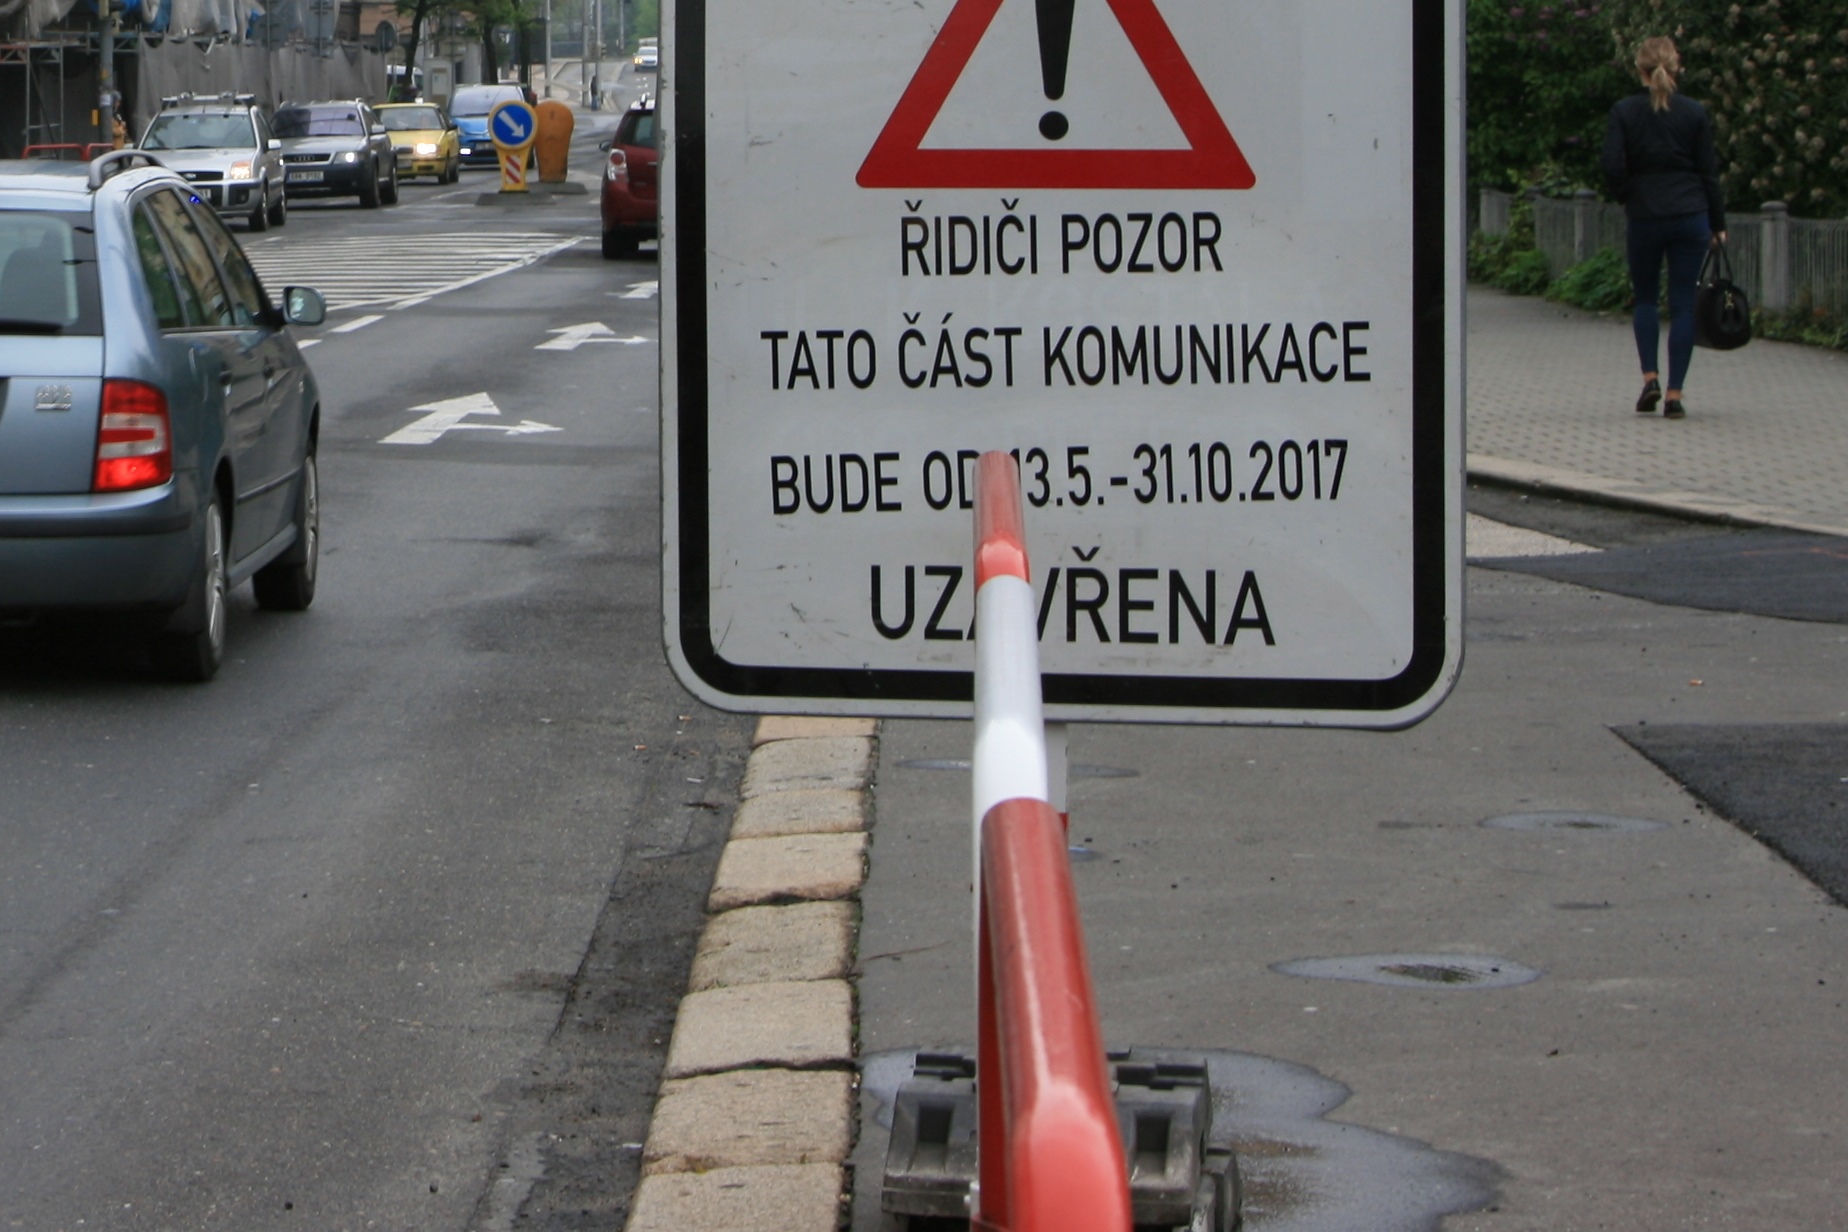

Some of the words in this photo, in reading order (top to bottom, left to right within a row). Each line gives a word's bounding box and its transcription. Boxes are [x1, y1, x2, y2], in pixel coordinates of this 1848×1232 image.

[900, 198, 1039, 277] ŘIDIČI
[1061, 211, 1224, 275] POZOR
[759, 329, 878, 391] TATO
[897, 312, 1023, 390] ČÁST
[1043, 320, 1372, 387] KOMUNIKACE
[770, 451, 903, 516] BUDE
[870, 545, 1277, 647] UZVŘENA
